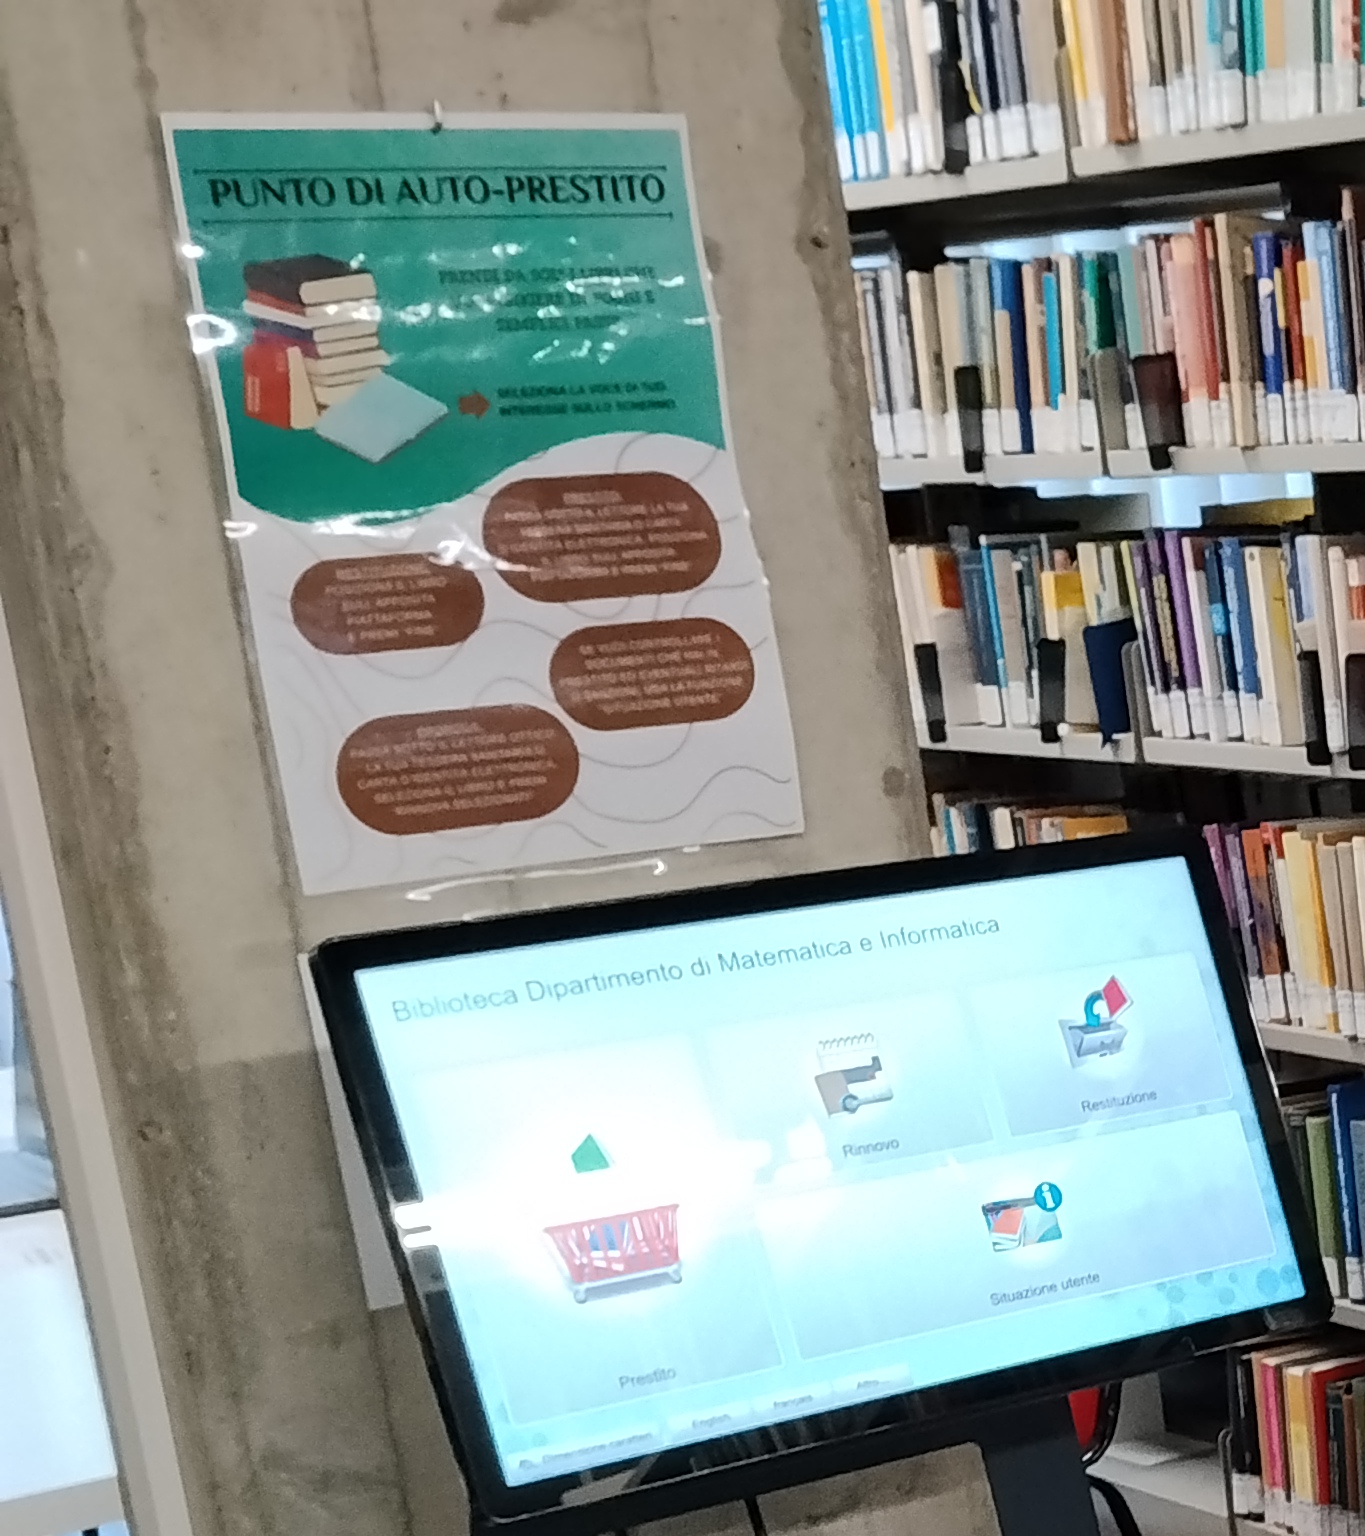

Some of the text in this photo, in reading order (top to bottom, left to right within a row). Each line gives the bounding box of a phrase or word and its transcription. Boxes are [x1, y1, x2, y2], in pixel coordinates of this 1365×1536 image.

[208, 172, 667, 208] PUNTO DI AUTO-PRESTITO
[391, 915, 1001, 1023] Biblioteca Dipartimento di Matematica e Informatica
[1081, 1088, 1158, 1113] Restituzione
[842, 1137, 900, 1158] Rinnovo
[989, 1272, 1101, 1307] Situazione utente
[618, 1366, 677, 1389] Prestito
